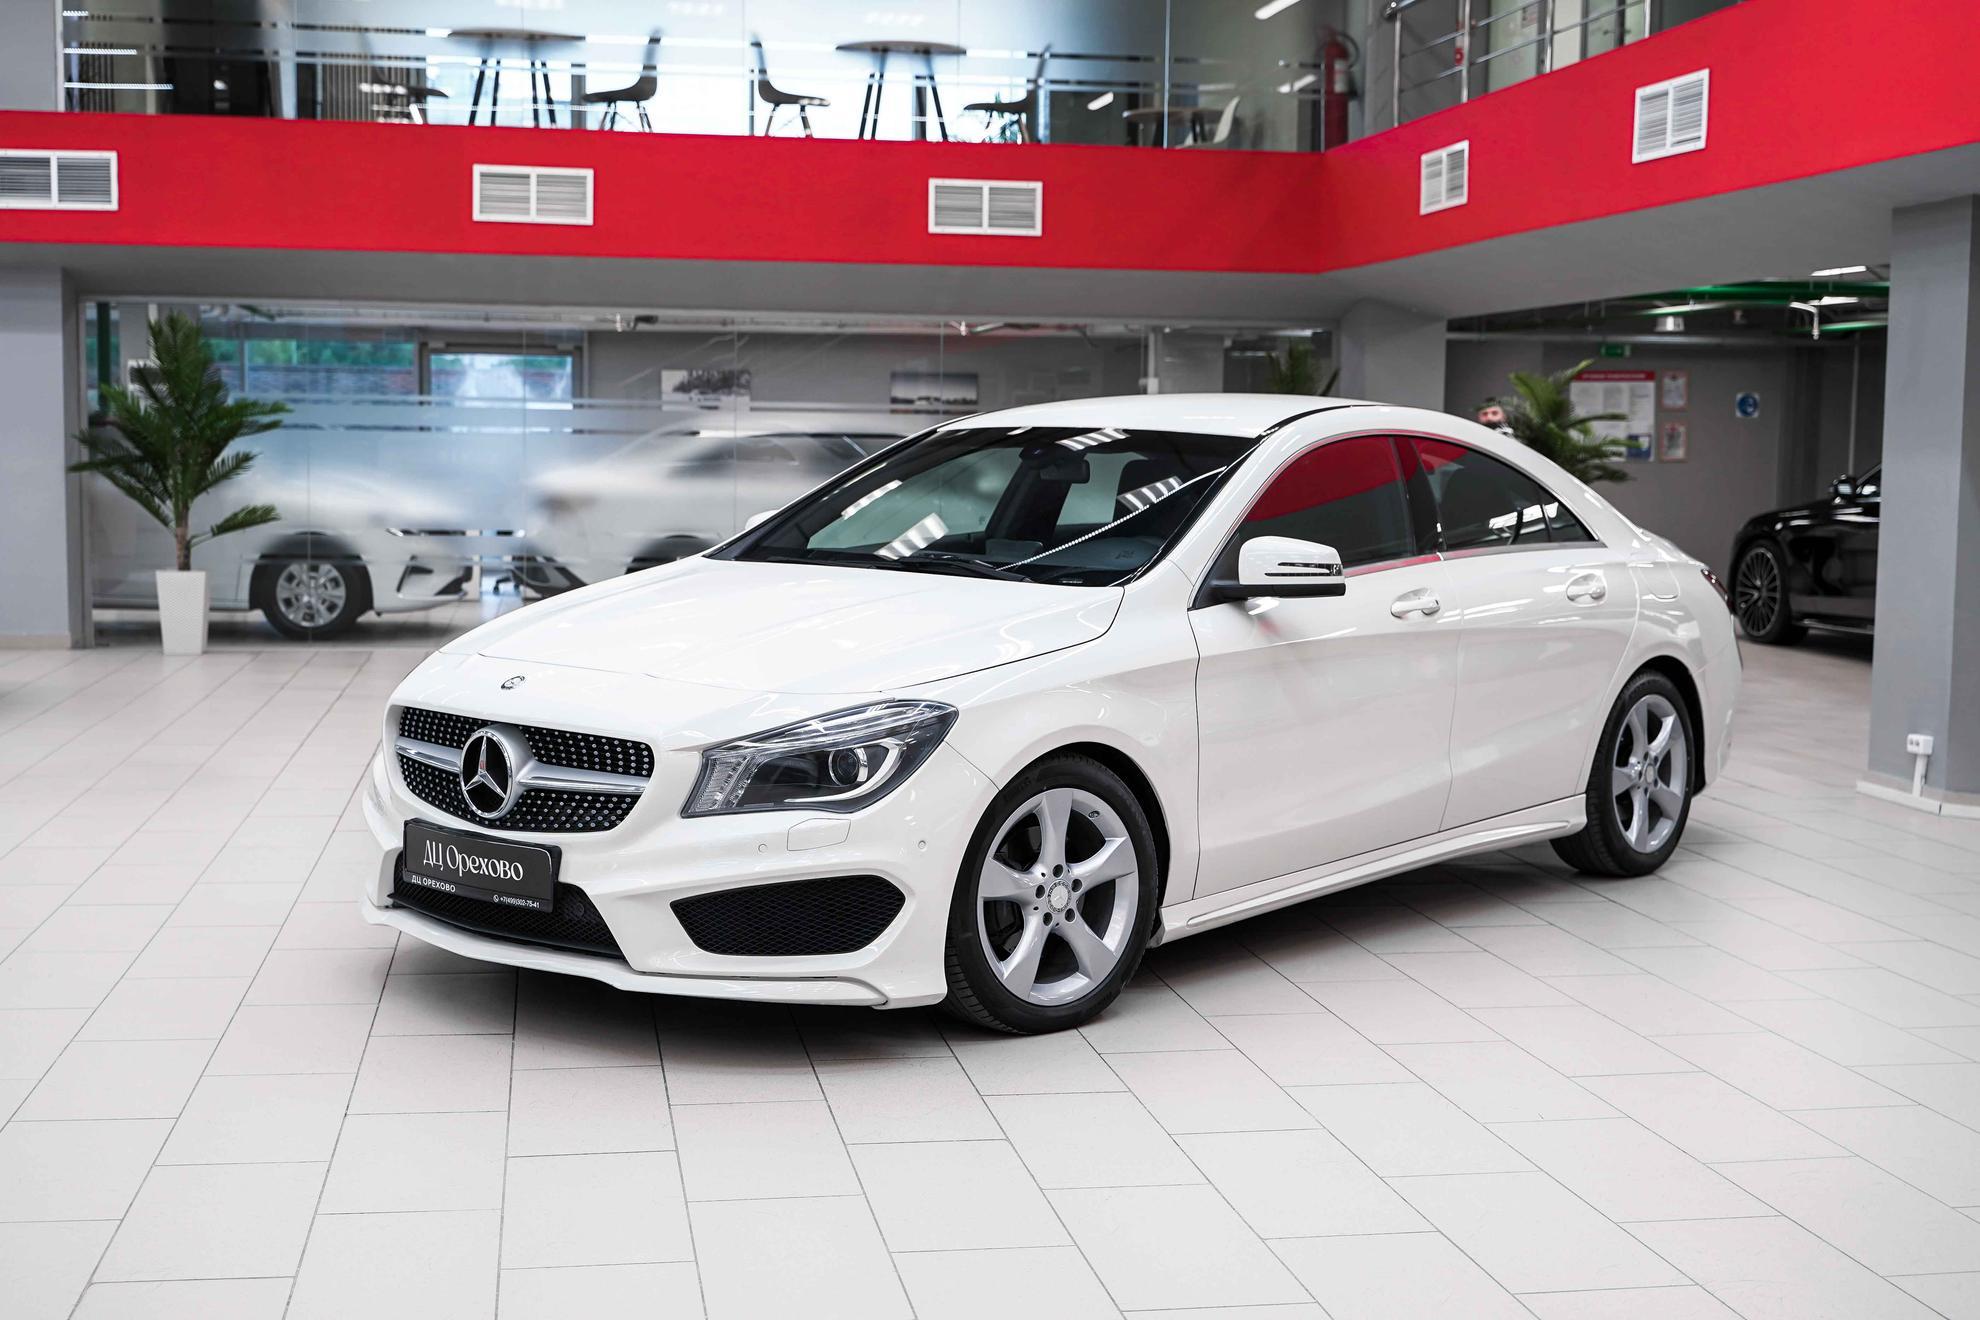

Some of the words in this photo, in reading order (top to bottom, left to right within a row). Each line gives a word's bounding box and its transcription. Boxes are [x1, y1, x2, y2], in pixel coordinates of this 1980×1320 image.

[423, 840, 444, 871] ДЦ
[446, 844, 524, 881] Орехово
[411, 875, 422, 886] ДЦ
[422, 878, 456, 893] ОРЕХОВО
